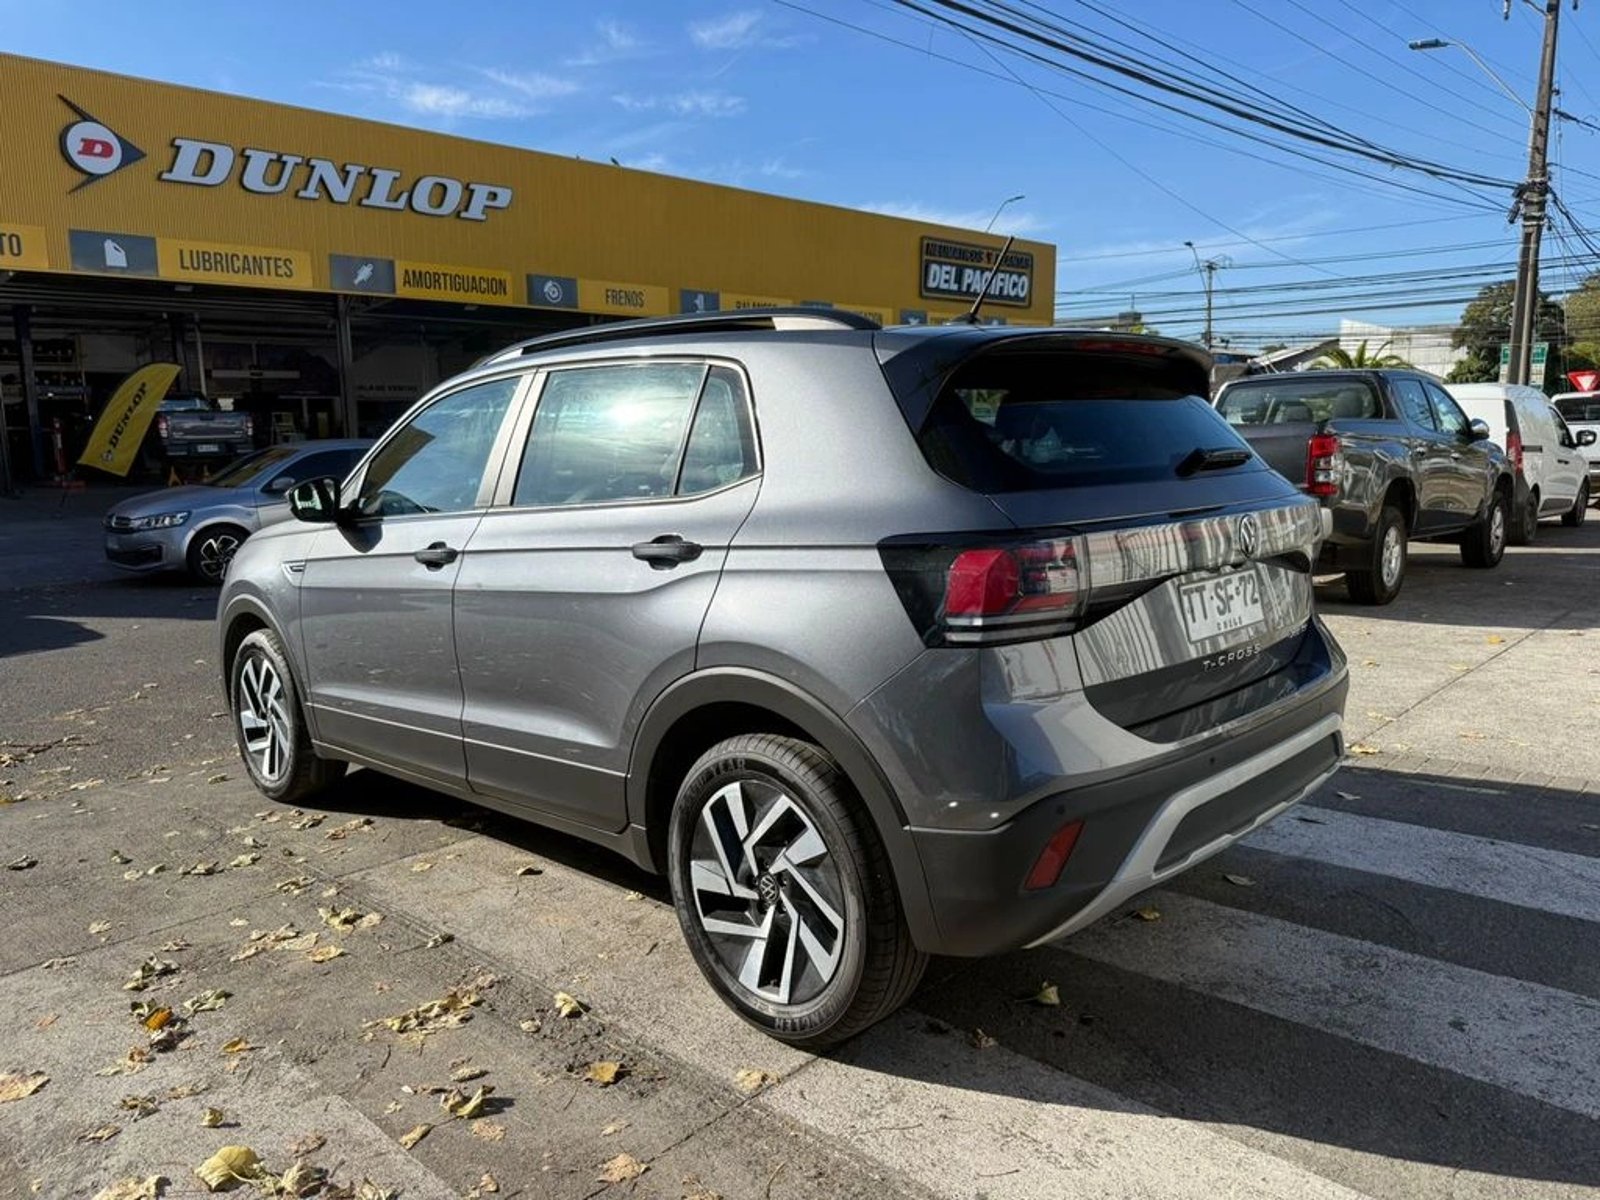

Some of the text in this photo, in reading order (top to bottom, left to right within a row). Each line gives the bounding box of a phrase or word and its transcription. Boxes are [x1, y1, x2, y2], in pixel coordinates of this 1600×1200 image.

[160, 137, 513, 222] DUNLOP
[178, 247, 294, 279] LUBRICANTES
[926, 263, 959, 291] DEL
[402, 268, 508, 297] AMORTIGUACION
[605, 288, 645, 309] FRENOS
[108, 381, 147, 448] DUNLOP
[1202, 643, 1261, 672] T-CROSS
